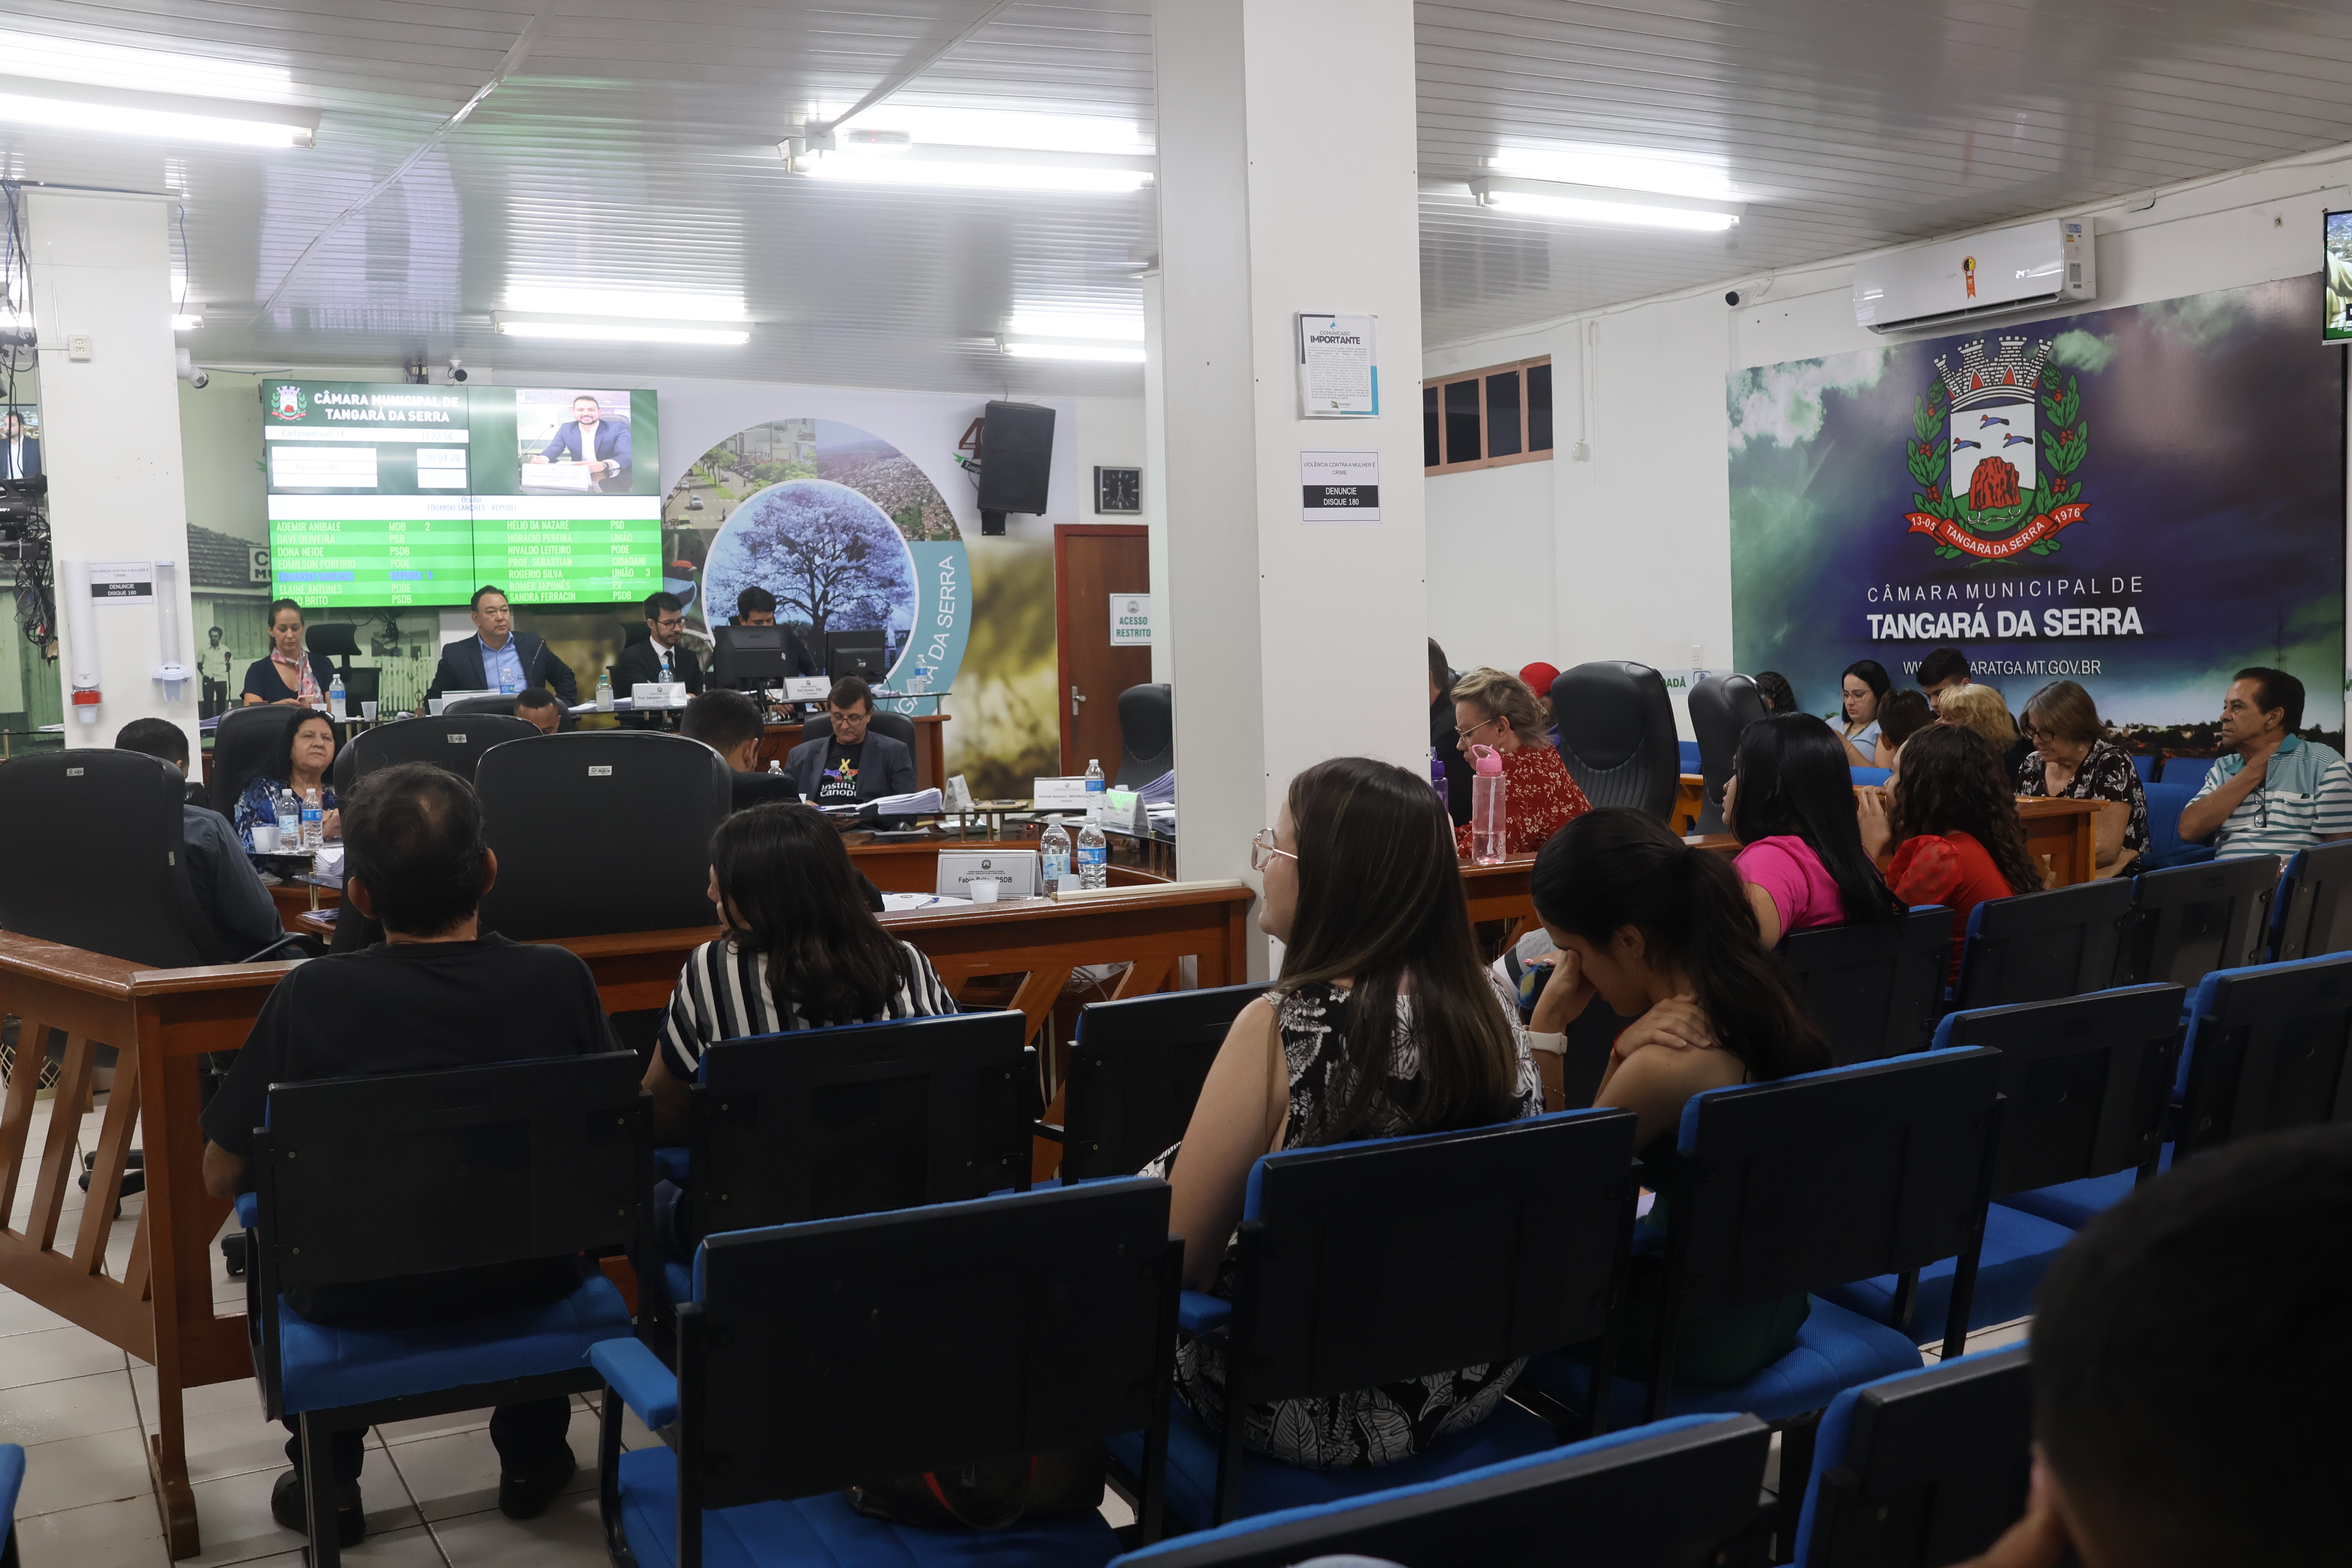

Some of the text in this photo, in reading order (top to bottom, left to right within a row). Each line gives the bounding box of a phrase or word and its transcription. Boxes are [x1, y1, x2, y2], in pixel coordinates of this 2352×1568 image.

[1310, 335, 1360, 344] IMPORTANTE
[314, 390, 459, 407] CÂMARA MUNICIPAL DE
[325, 407, 450, 422] TANGARÁ DA SERRA
[282, 429, 334, 438] Parlamentares
[2054, 507, 2080, 524] 1976
[276, 522, 430, 532] ADEMIR ANIBALE MDB 2
[507, 519, 624, 530] HÉLIO DA NAZARÉ PSD
[1911, 517, 1936, 531] 13-05
[277, 534, 405, 544] DAVI OLIVEIRA PSB
[508, 532, 633, 543] HORACIO PEREIRA UNIÃO
[1945, 522, 2045, 555] TANGARÁ DA SERRA
[278, 546, 410, 557] DONA NEIDE PSDB
[508, 545, 630, 555] NIVALDO LEITEIRO PODE
[278, 559, 410, 569] EDMILSON PORFIRIO PODE
[508, 557, 646, 567] PROF. SEBASTIAN CIDADANI
[278, 571, 432, 582] EDUARDO SANCHES REPUBLI 1
[509, 567, 651, 579] ROGERIO SILVA UNIÃO 3
[279, 583, 411, 594] ELAINE ANTUNES PODE
[509, 579, 622, 591] ROMER JAPONÊS PV
[1867, 576, 2143, 603] CÂMARA MUNICIPAL DE
[510, 591, 632, 602] SANDRA FERRACIN PSDB
[937, 555, 956, 628] SERRA
[305, 595, 328, 605] BRITO
[392, 595, 412, 604] PSDB
[1120, 617, 1147, 625] ACESSO
[1866, 603, 2144, 639] TANGARÁ DA SERRA
[1116, 629, 1151, 637] RESTRITO
[928, 633, 950, 661] DA
